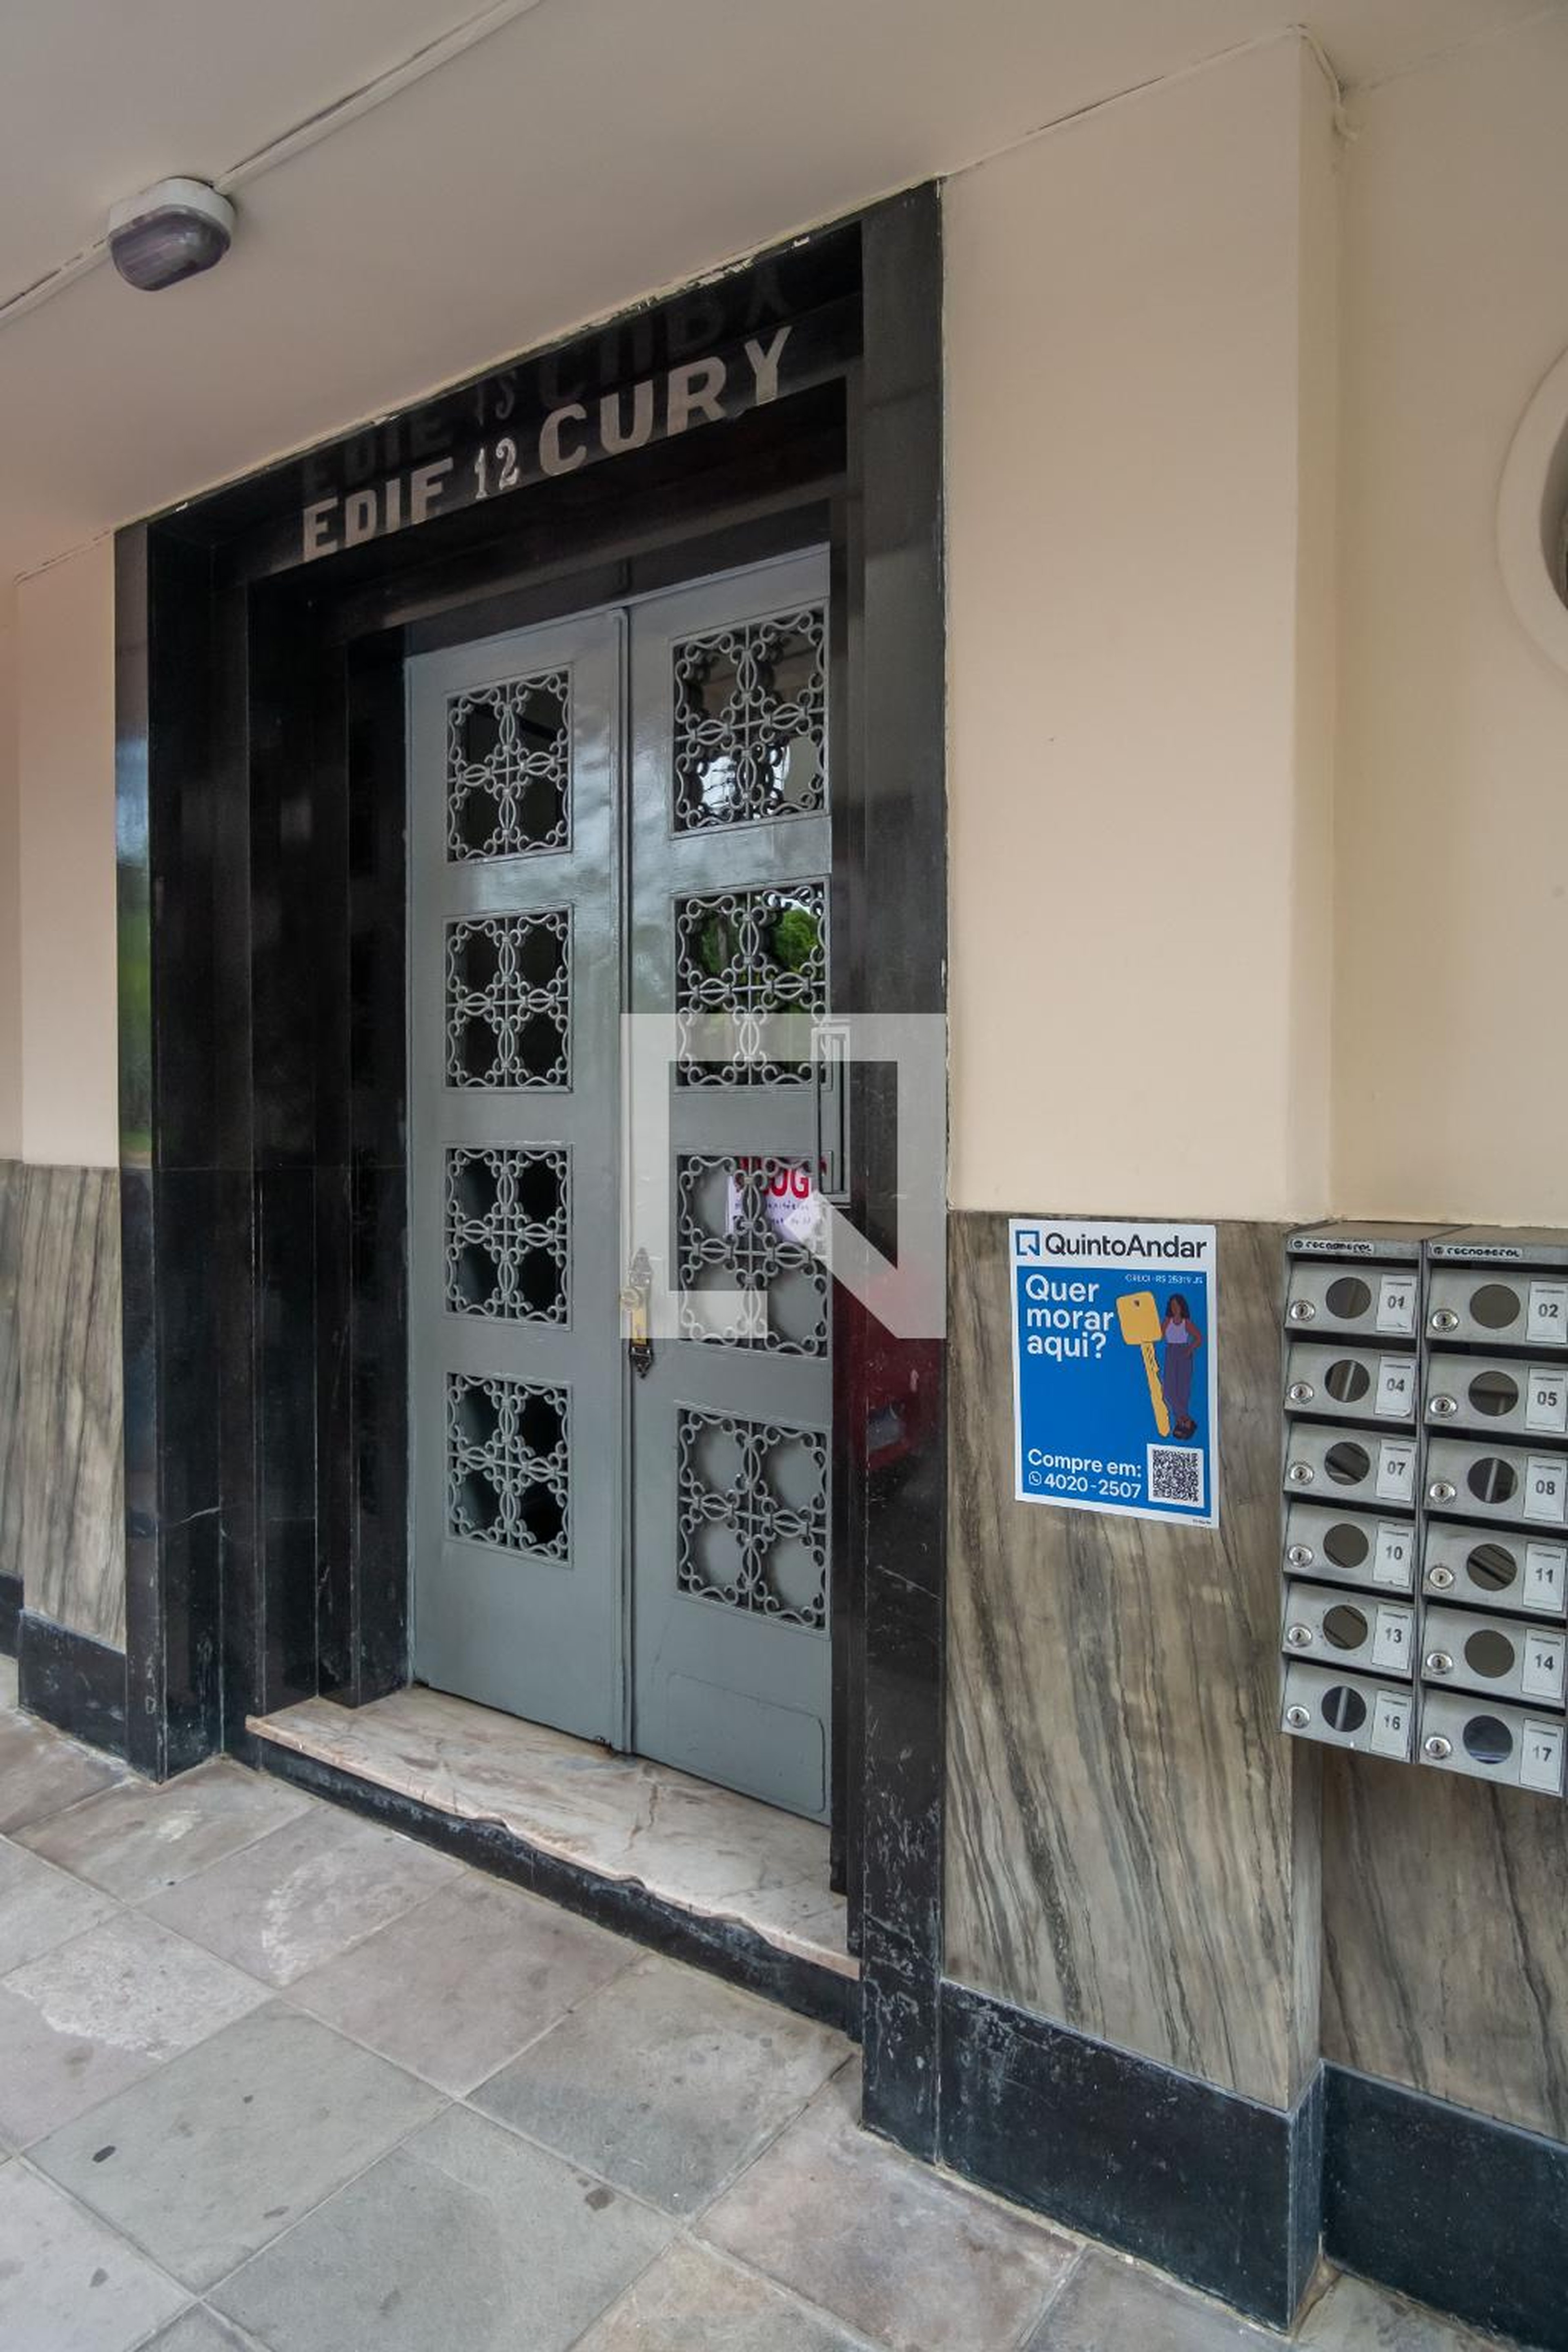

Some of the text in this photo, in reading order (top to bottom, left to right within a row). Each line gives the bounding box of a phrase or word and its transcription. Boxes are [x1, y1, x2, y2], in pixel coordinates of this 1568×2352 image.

[303, 326, 793, 563] EDIF 12 CURY
[1045, 1232, 1207, 1258] QuintoAndar
[1025, 1274, 1100, 1302] Quer
[1387, 1295, 1405, 1308] 01
[1538, 1302, 1559, 1318] 02
[1027, 1307, 1114, 1332] morar
[1027, 1331, 1107, 1362] aqui?
[1387, 1378, 1405, 1392] 04
[1537, 1390, 1557, 1406] 05
[1027, 1448, 1142, 1478] Compre em:
[1387, 1461, 1406, 1475] 07
[1535, 1480, 1556, 1495] 08
[1385, 1545, 1403, 1560] 10
[1535, 1567, 1554, 1584] 11
[1385, 1628, 1403, 1644] 13
[1535, 1654, 1555, 1671] 14
[1383, 1715, 1401, 1731] 16
[1532, 1745, 1552, 1762] 17
